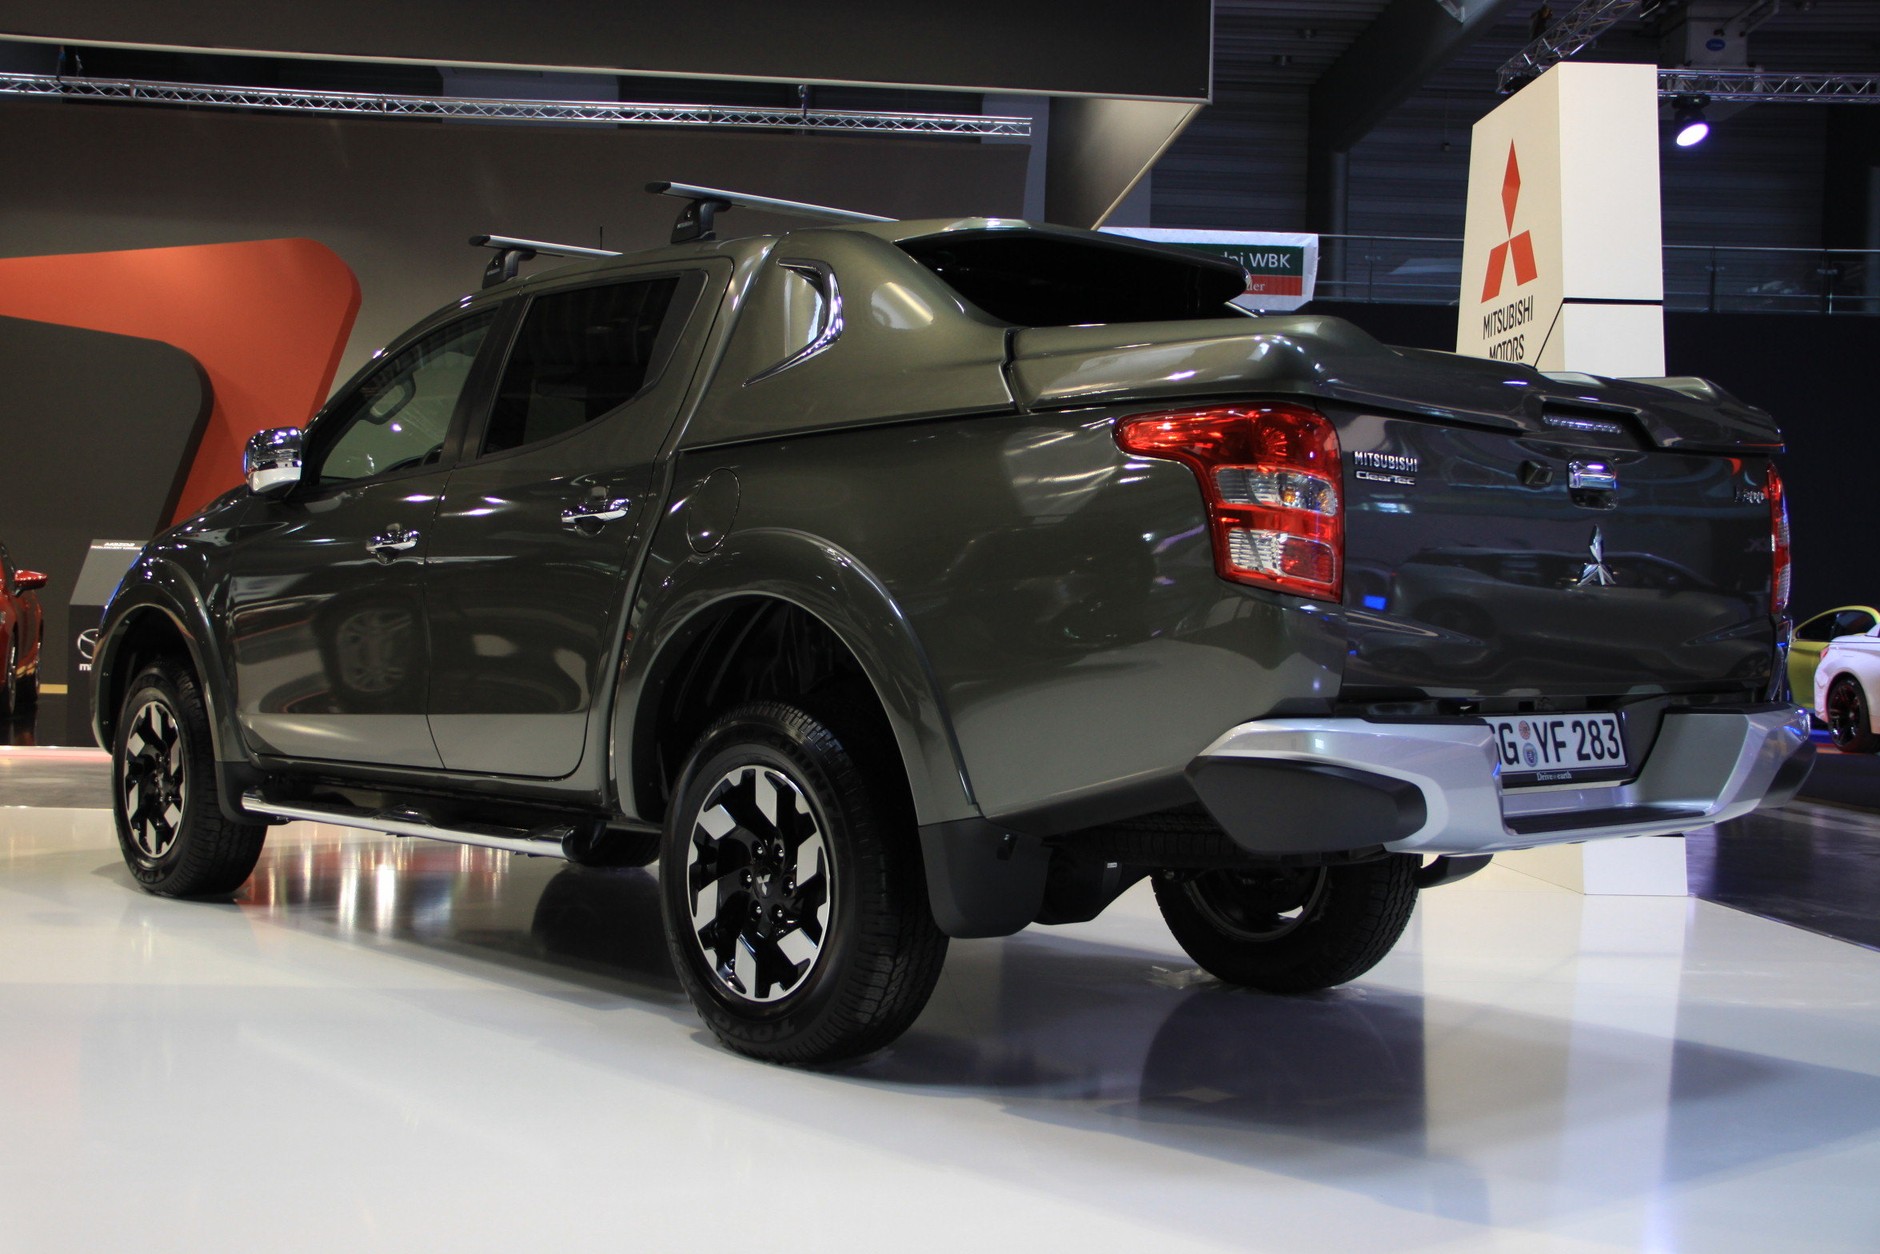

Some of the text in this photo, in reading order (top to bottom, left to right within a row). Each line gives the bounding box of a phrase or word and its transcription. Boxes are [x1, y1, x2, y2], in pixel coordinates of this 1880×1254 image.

[1249, 253, 1290, 268] WBK
[1483, 295, 1533, 340] MITSUBISHI
[1489, 334, 1524, 362] MOTORS
[1354, 451, 1418, 472] MITSUBISHI
[1356, 471, 1416, 485] ClearTec
[1486, 719, 1620, 765] G YF 283
